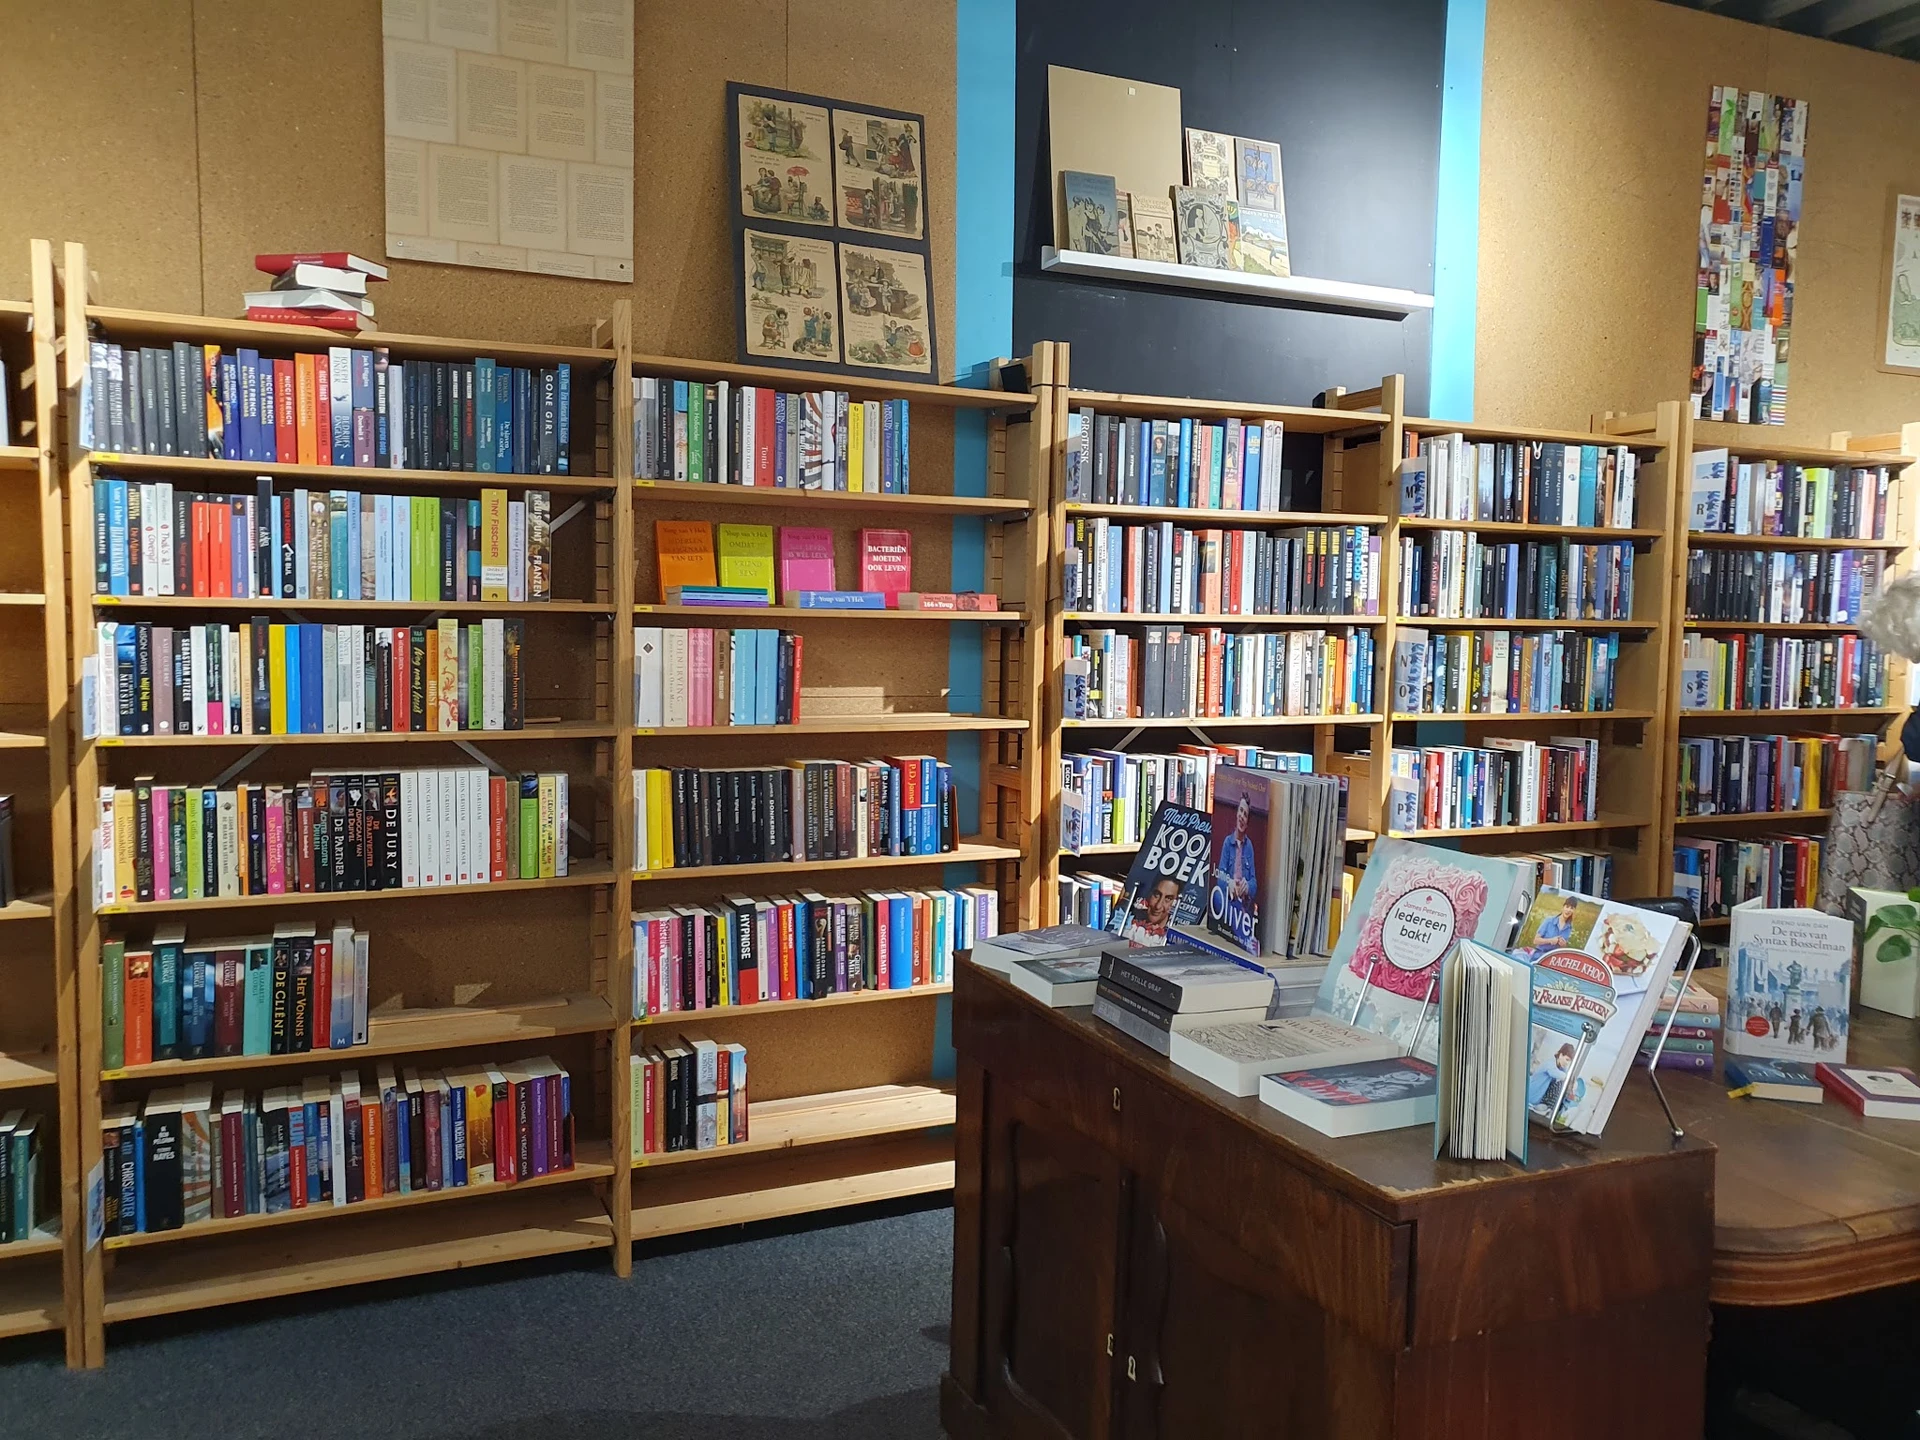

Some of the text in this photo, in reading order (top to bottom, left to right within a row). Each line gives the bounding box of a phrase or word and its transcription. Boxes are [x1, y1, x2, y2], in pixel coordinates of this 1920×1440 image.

[333, 355, 341, 383] FINDER
[249, 388, 257, 417] FRENCH
[545, 374, 553, 436] GONE GIRL
[334, 415, 342, 447] ONGEVAL
[1080, 415, 1090, 463] GROTESK
[1405, 486, 1416, 499] M
[98, 513, 106, 522] DE
[1696, 503, 1704, 515] R
[491, 499, 499, 558] TINY FISSCHER
[1361, 526, 1369, 554] JENS
[533, 494, 542, 597] KRUISPUNT FRANZEN
[867, 545, 907, 573] BACTERIËN MOETEN OOK LEVEN
[1173, 557, 1182, 566] DE
[1345, 551, 1353, 598] ONDER NUL
[1360, 554, 1369, 600] LAPIDUS
[182, 638, 191, 675] SEBASTIAN
[472, 646, 481, 669] Green
[1400, 654, 1408, 668] N
[1399, 684, 1407, 698] O
[1686, 682, 1693, 694] S
[881, 771, 889, 804] ED JAMES
[908, 763, 917, 804] P.D. James
[320, 810, 328, 834] ACHTER
[348, 808, 355, 817] DE
[1163, 807, 1189, 827] Matt
[1397, 802, 1404, 815] P
[313, 823, 321, 850] DEUREN
[373, 820, 380, 830] DE
[385, 808, 397, 869] DE JURY
[495, 817, 503, 836] Trouw
[174, 837, 182, 873] Aandenken
[206, 831, 214, 883] MOORDMOTIEVEN
[269, 845, 277, 873] LEUGENS
[334, 818, 345, 877] DE PARTNER
[495, 852, 503, 863] mij
[1143, 845, 1210, 888] BOEK
[1211, 862, 1231, 883] Jamie
[1182, 893, 1197, 905] 187
[1210, 885, 1259, 940] Oliver
[1403, 900, 1448, 919] James Peterson
[1394, 907, 1448, 933] Iedereen
[1771, 919, 1794, 928] AREND
[1796, 921, 1812, 929] VAN
[1771, 925, 1828, 941] De reis van
[740, 914, 751, 960] HYPNOSE
[1399, 927, 1432, 944] bakt!
[1753, 934, 1788, 948] Syntax
[1790, 938, 1846, 953] Bosselman
[162, 954, 170, 984] GEORGE
[193, 961, 201, 988] GEORGE
[223, 960, 231, 987] GEORGE
[1120, 970, 1162, 993] HET STILLE GRAF
[1549, 956, 1605, 982] RACHEL KHOO
[274, 970, 288, 1036] DE CLIËNT
[295, 977, 307, 1037] HET VONNIS
[1538, 989, 1573, 1006] FRANSE
[1571, 994, 1610, 1019] KEUKEN
[367, 1108, 376, 1136] HANNAH
[520, 1101, 528, 1124] HOMES
[521, 1161, 529, 1176] ONS
